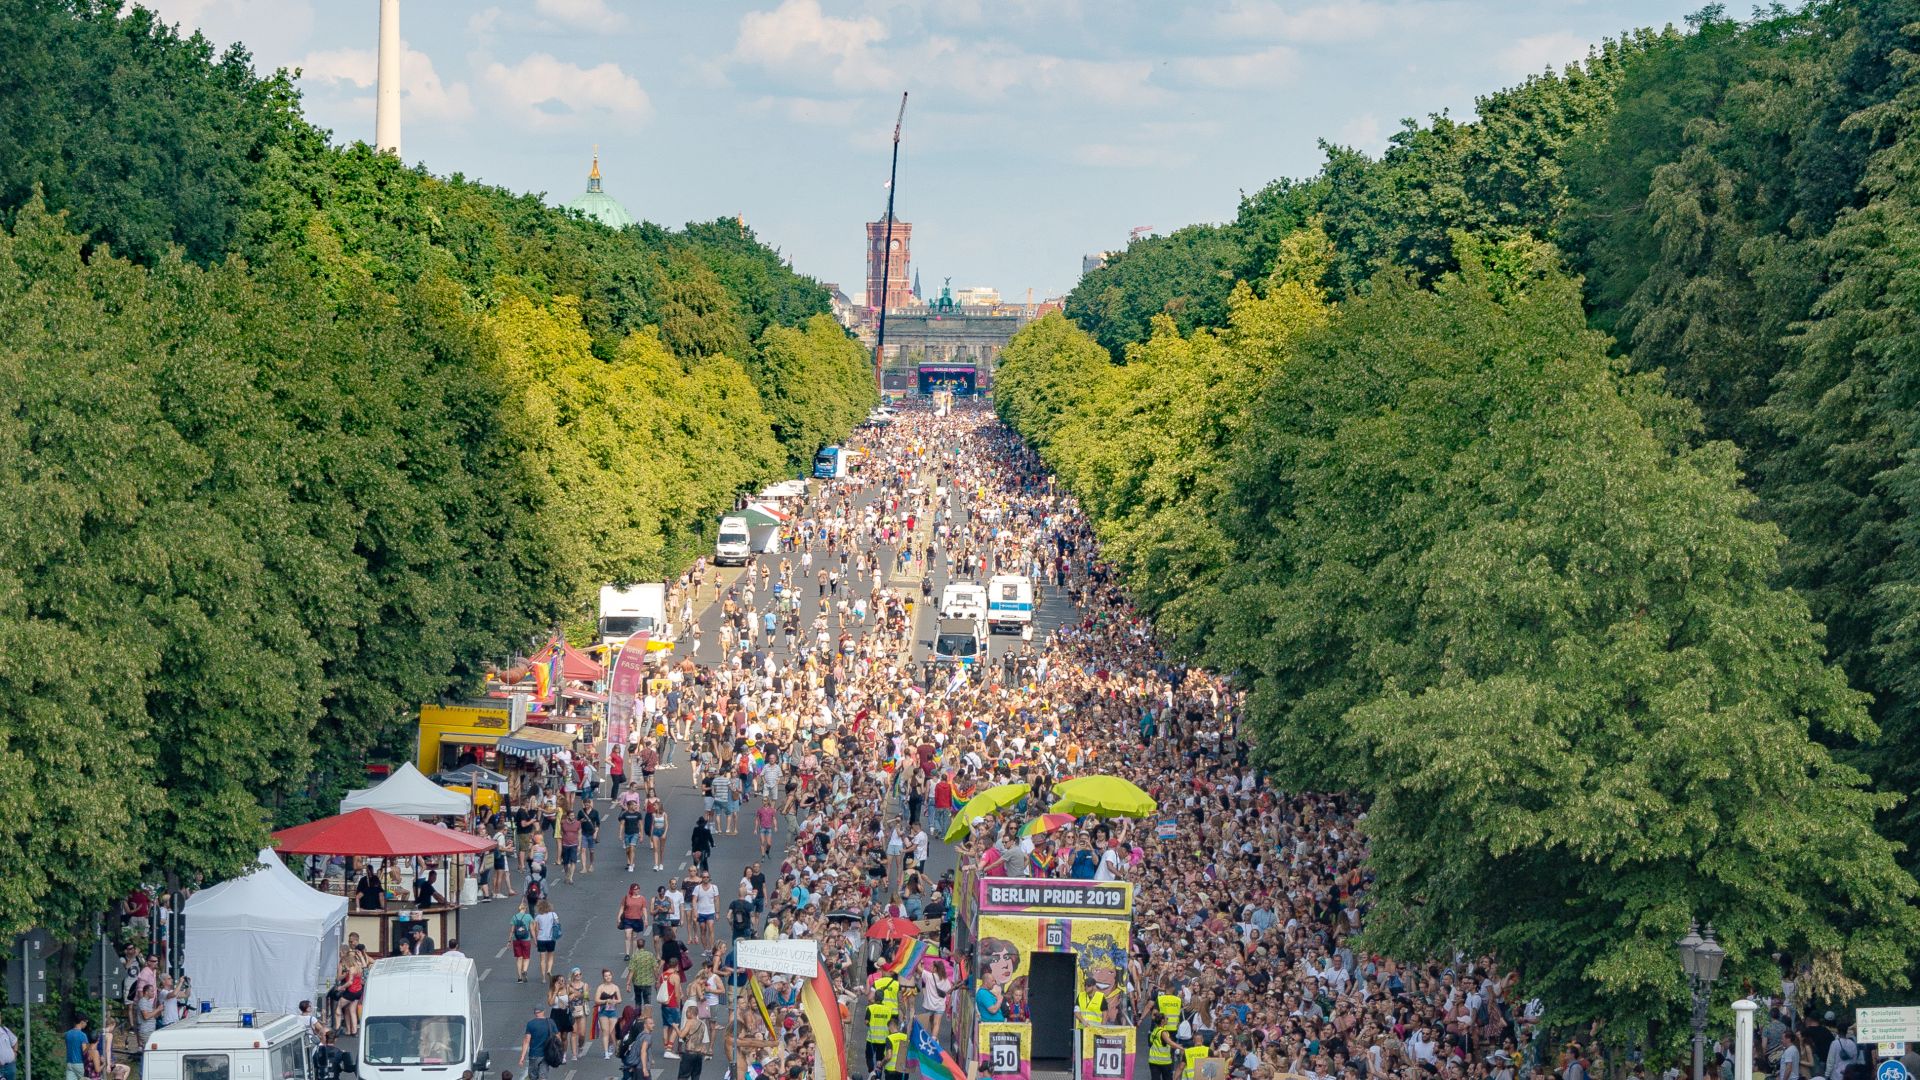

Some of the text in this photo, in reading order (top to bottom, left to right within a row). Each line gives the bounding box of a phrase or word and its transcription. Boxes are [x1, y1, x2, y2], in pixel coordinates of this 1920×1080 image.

[621, 660, 641, 671] FASS
[991, 887, 1121, 906] BERLIN PRIDE 2019
[1049, 933, 1060, 943] 50
[996, 1050, 1016, 1067] 50
[1099, 1052, 1119, 1070] 40
[241, 1065, 251, 1073] 11
